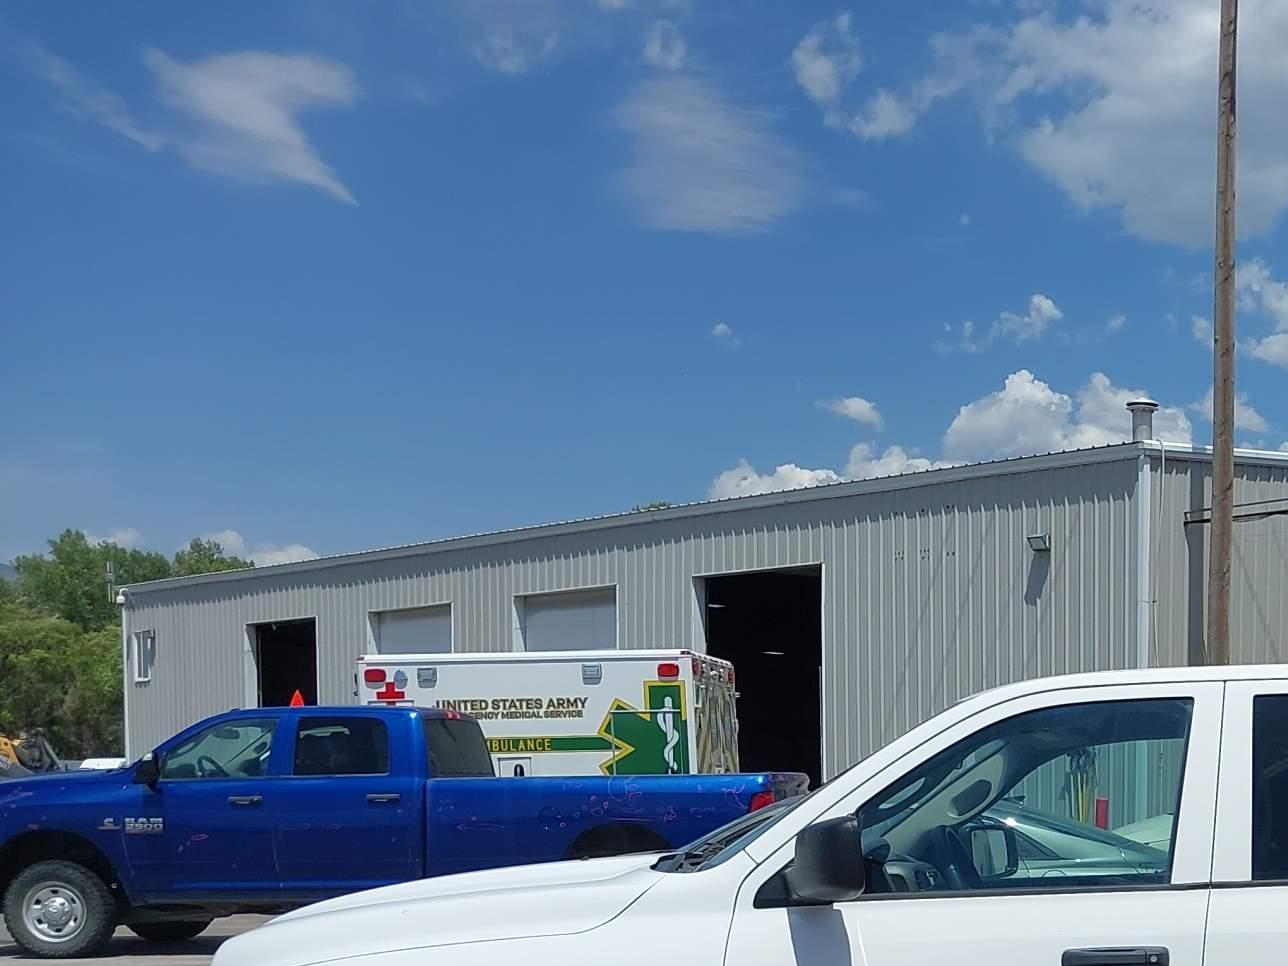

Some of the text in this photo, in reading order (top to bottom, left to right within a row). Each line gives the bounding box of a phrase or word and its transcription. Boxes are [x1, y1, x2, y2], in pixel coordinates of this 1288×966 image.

[435, 697, 589, 711] UNITED STATES ARMY
[501, 710, 544, 719] MEDICAL
[544, 709, 584, 719] SERVICE
